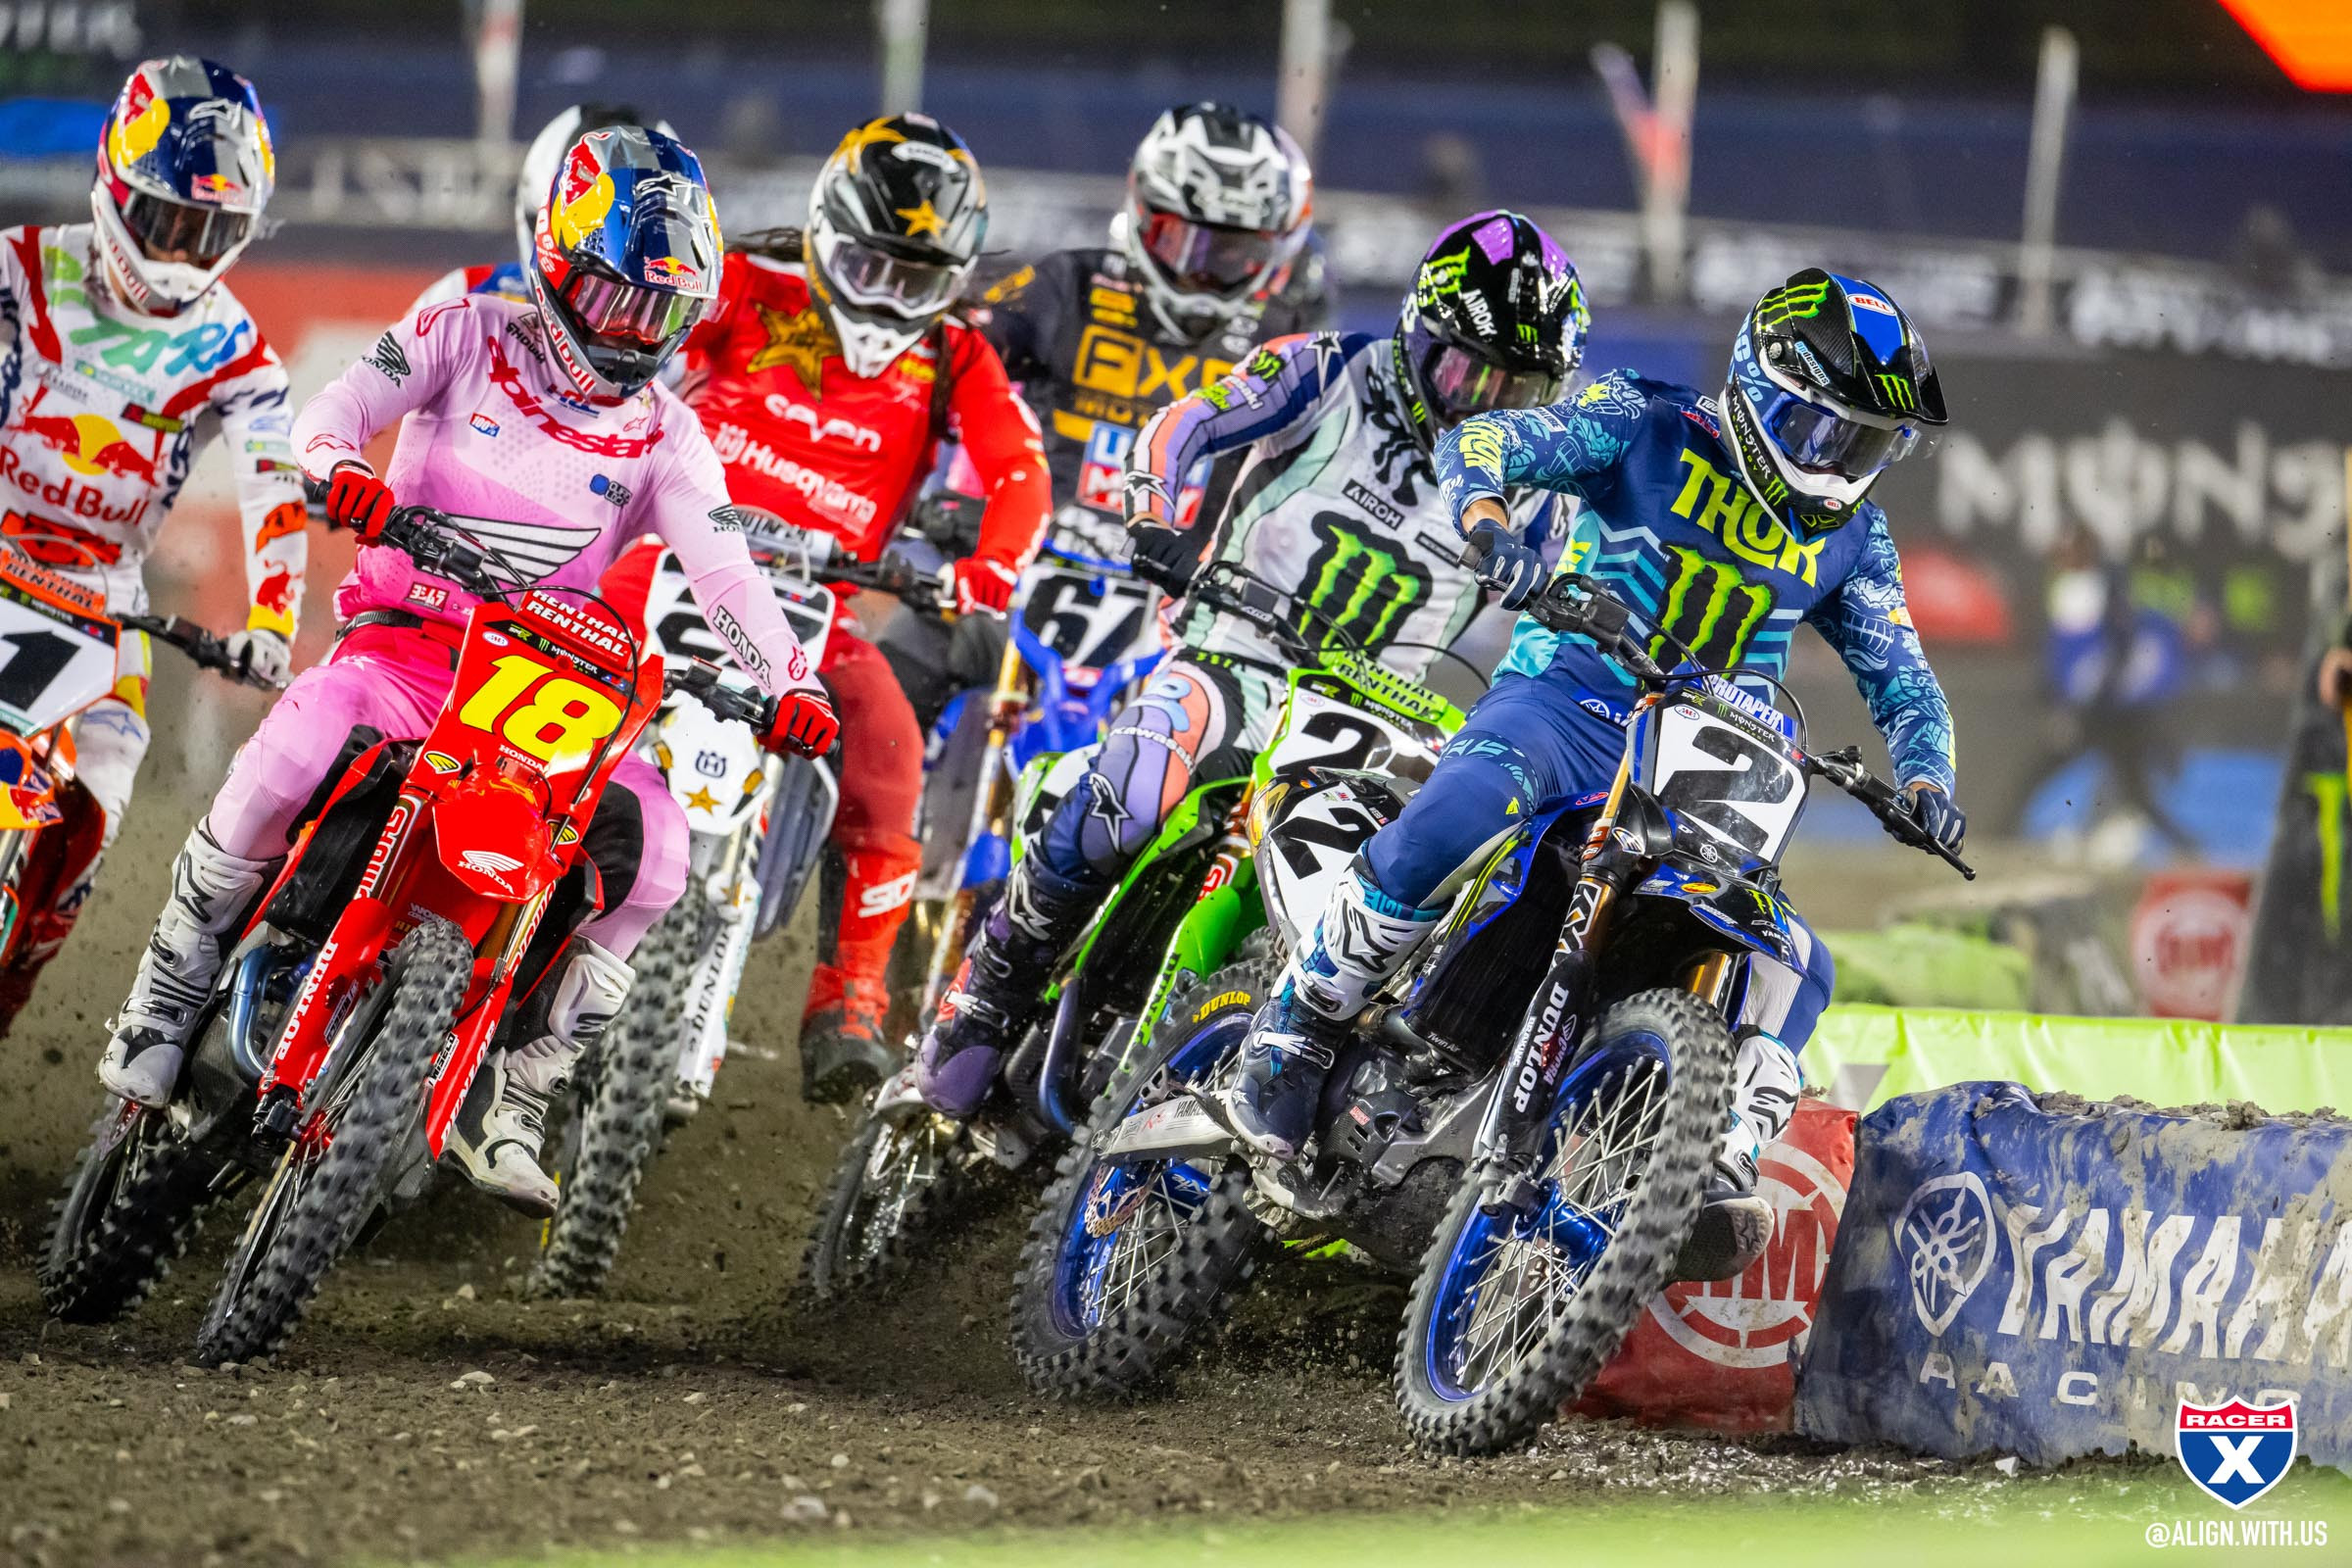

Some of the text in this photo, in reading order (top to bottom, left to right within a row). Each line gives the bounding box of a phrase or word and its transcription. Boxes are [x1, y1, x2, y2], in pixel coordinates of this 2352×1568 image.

[644, 270, 703, 291] Red Bull
[1854, 296, 1890, 312] BELL
[363, 356, 402, 388] ONDA
[472, 414, 500, 437] 100%
[1733, 394, 1771, 480] MONSTER
[0, 447, 151, 526] Red Bull
[1347, 483, 1401, 528] AIROH
[1827, 501, 1840, 510] BELL
[1670, 448, 1827, 588] THOR
[526, 601, 627, 659] RENTHAL
[712, 605, 772, 689] HONDA
[0, 631, 81, 712] 1
[459, 654, 624, 764] 18
[1731, 710, 1775, 742] MONSTER
[499, 743, 549, 774] HONDA
[1659, 726, 1794, 856] 2
[353, 805, 410, 900] SHOW
[1274, 807, 1380, 881] 2
[458, 859, 514, 895] HONDA
[275, 941, 340, 1061] DUNLOP
[1200, 991, 1251, 1021] DUNLOP
[1427, 1031, 1446, 1050] Twin
[1514, 1016, 1536, 1068] BRAKING
[1514, 981, 1571, 1114] DUNLOP
